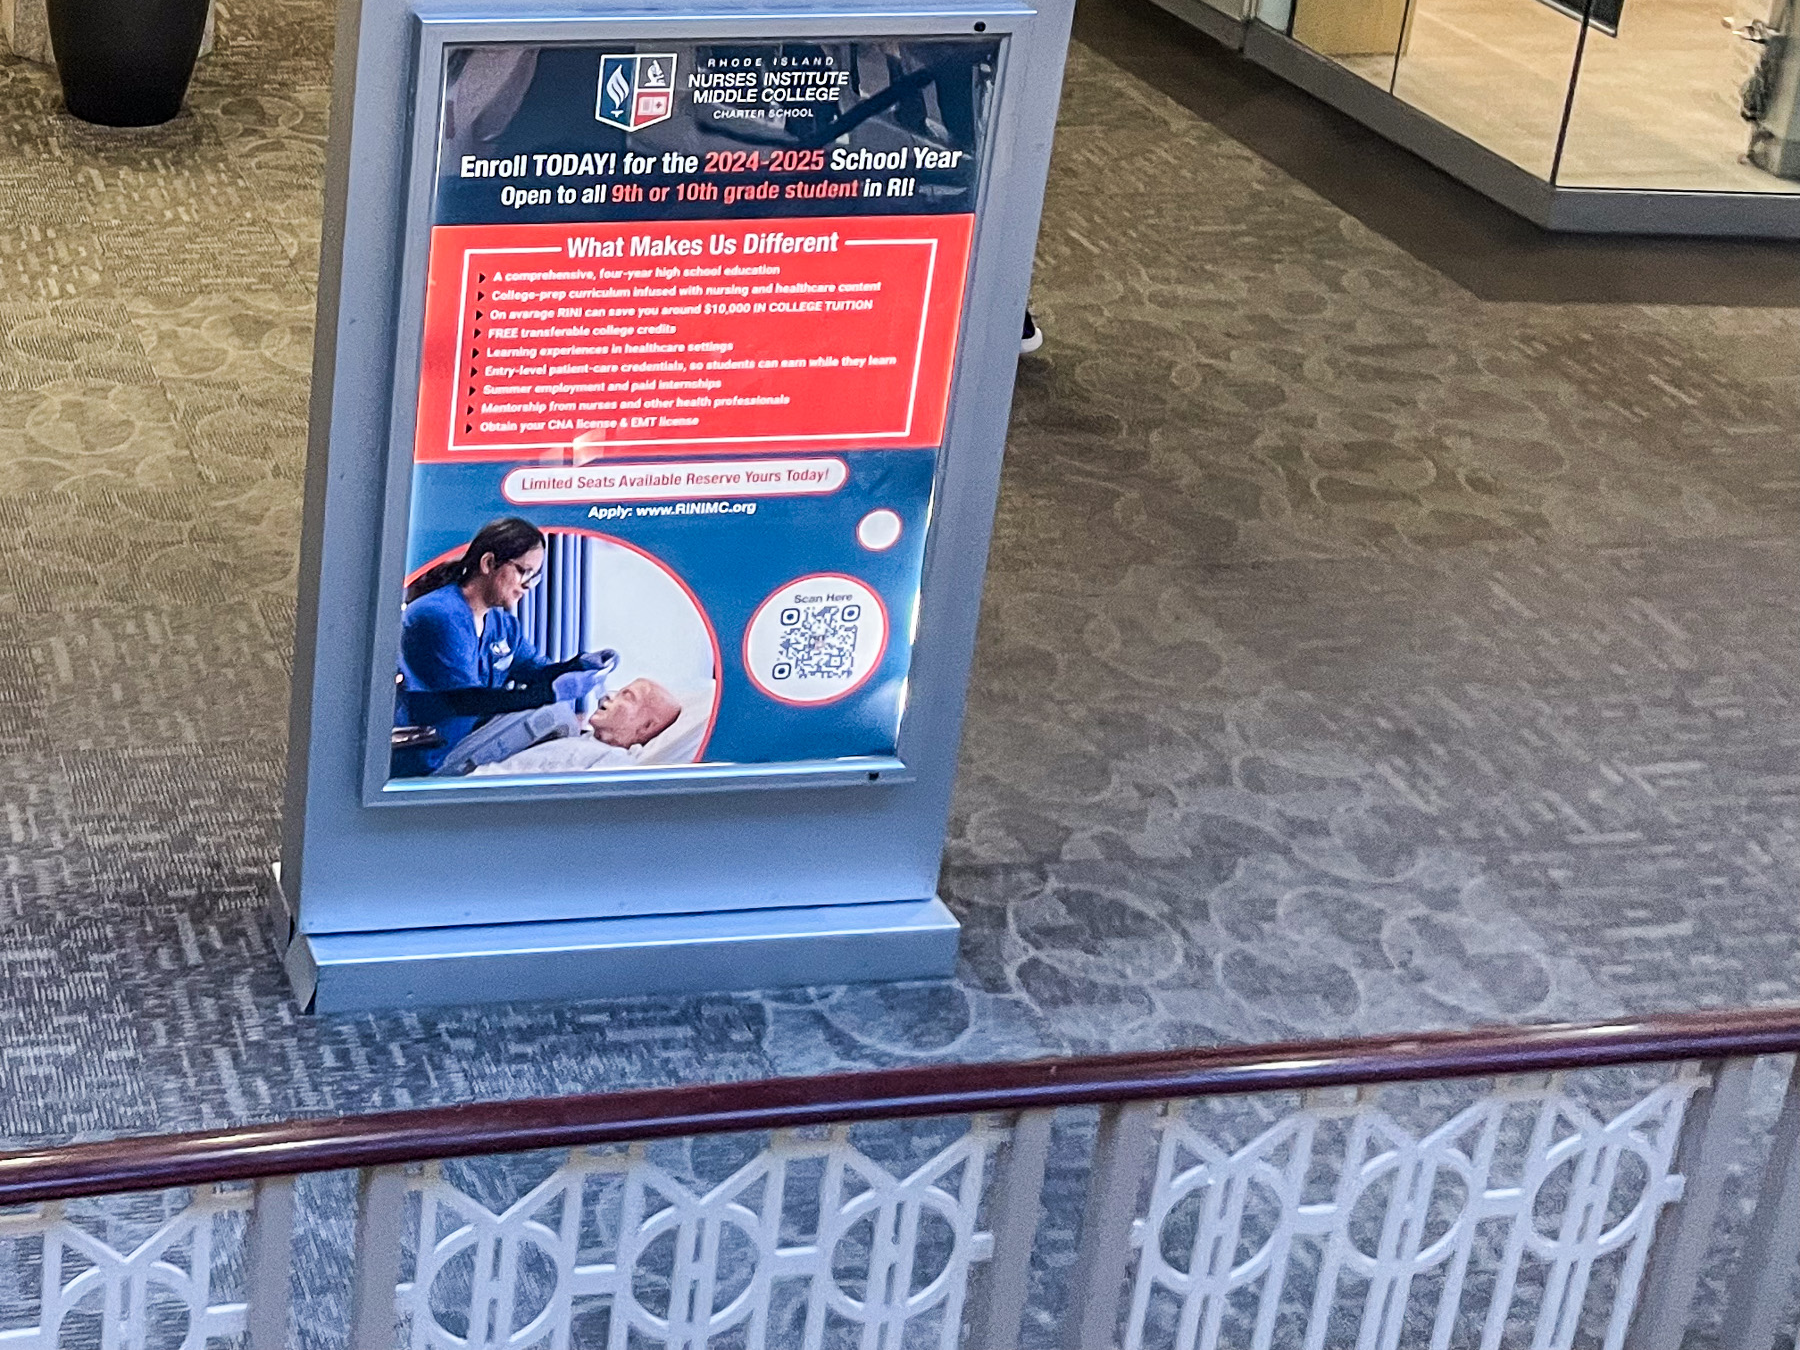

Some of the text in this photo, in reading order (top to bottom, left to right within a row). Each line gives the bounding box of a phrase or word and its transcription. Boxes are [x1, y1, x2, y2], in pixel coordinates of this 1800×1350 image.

[707, 56, 835, 68] RHODE ISLAND
[688, 71, 850, 88] NURSES INSTITUTE
[693, 87, 840, 104] MIDDLE COLLEGE
[713, 107, 814, 120] CHARTER SCHOOL
[460, 147, 963, 178] Enroll TODAY! for the 2024-2025 School Year
[501, 177, 915, 209] Open to all 9th or 10th grade student in RI!
[566, 232, 839, 258] What Makes Us Different
[493, 264, 780, 283] A comprehensive, four-year high school education
[492, 281, 881, 302] College-prep curriculum infused with nursing and healthcare content
[490, 309, 507, 320] On
[557, 307, 582, 319] RINI
[584, 308, 606, 318] can
[608, 307, 636, 317] save
[638, 306, 659, 319] you
[662, 304, 702, 315] around
[704, 303, 751, 316] $10,000
[753, 302, 766, 313] IN
[769, 301, 822, 313] COLLEGE
[824, 299, 873, 311] TUITION
[488, 324, 677, 339] FREE transferable college credits
[486, 341, 734, 360] Learning experiences in healthcare settings
[485, 354, 897, 378] Entry-level patient-care credentials, so students can earn while they learn
[483, 378, 722, 395] Summer employment and paid internships
[481, 394, 791, 415] Mentorship from nurses and other health professionals
[480, 415, 699, 433] Obtain your CNA license & EMT license
[521, 467, 830, 491] Limited Seats Available Reserve Yours Today!
[588, 501, 757, 520] Apply: www.RINIMC.org
[794, 592, 853, 604] Scan Here
